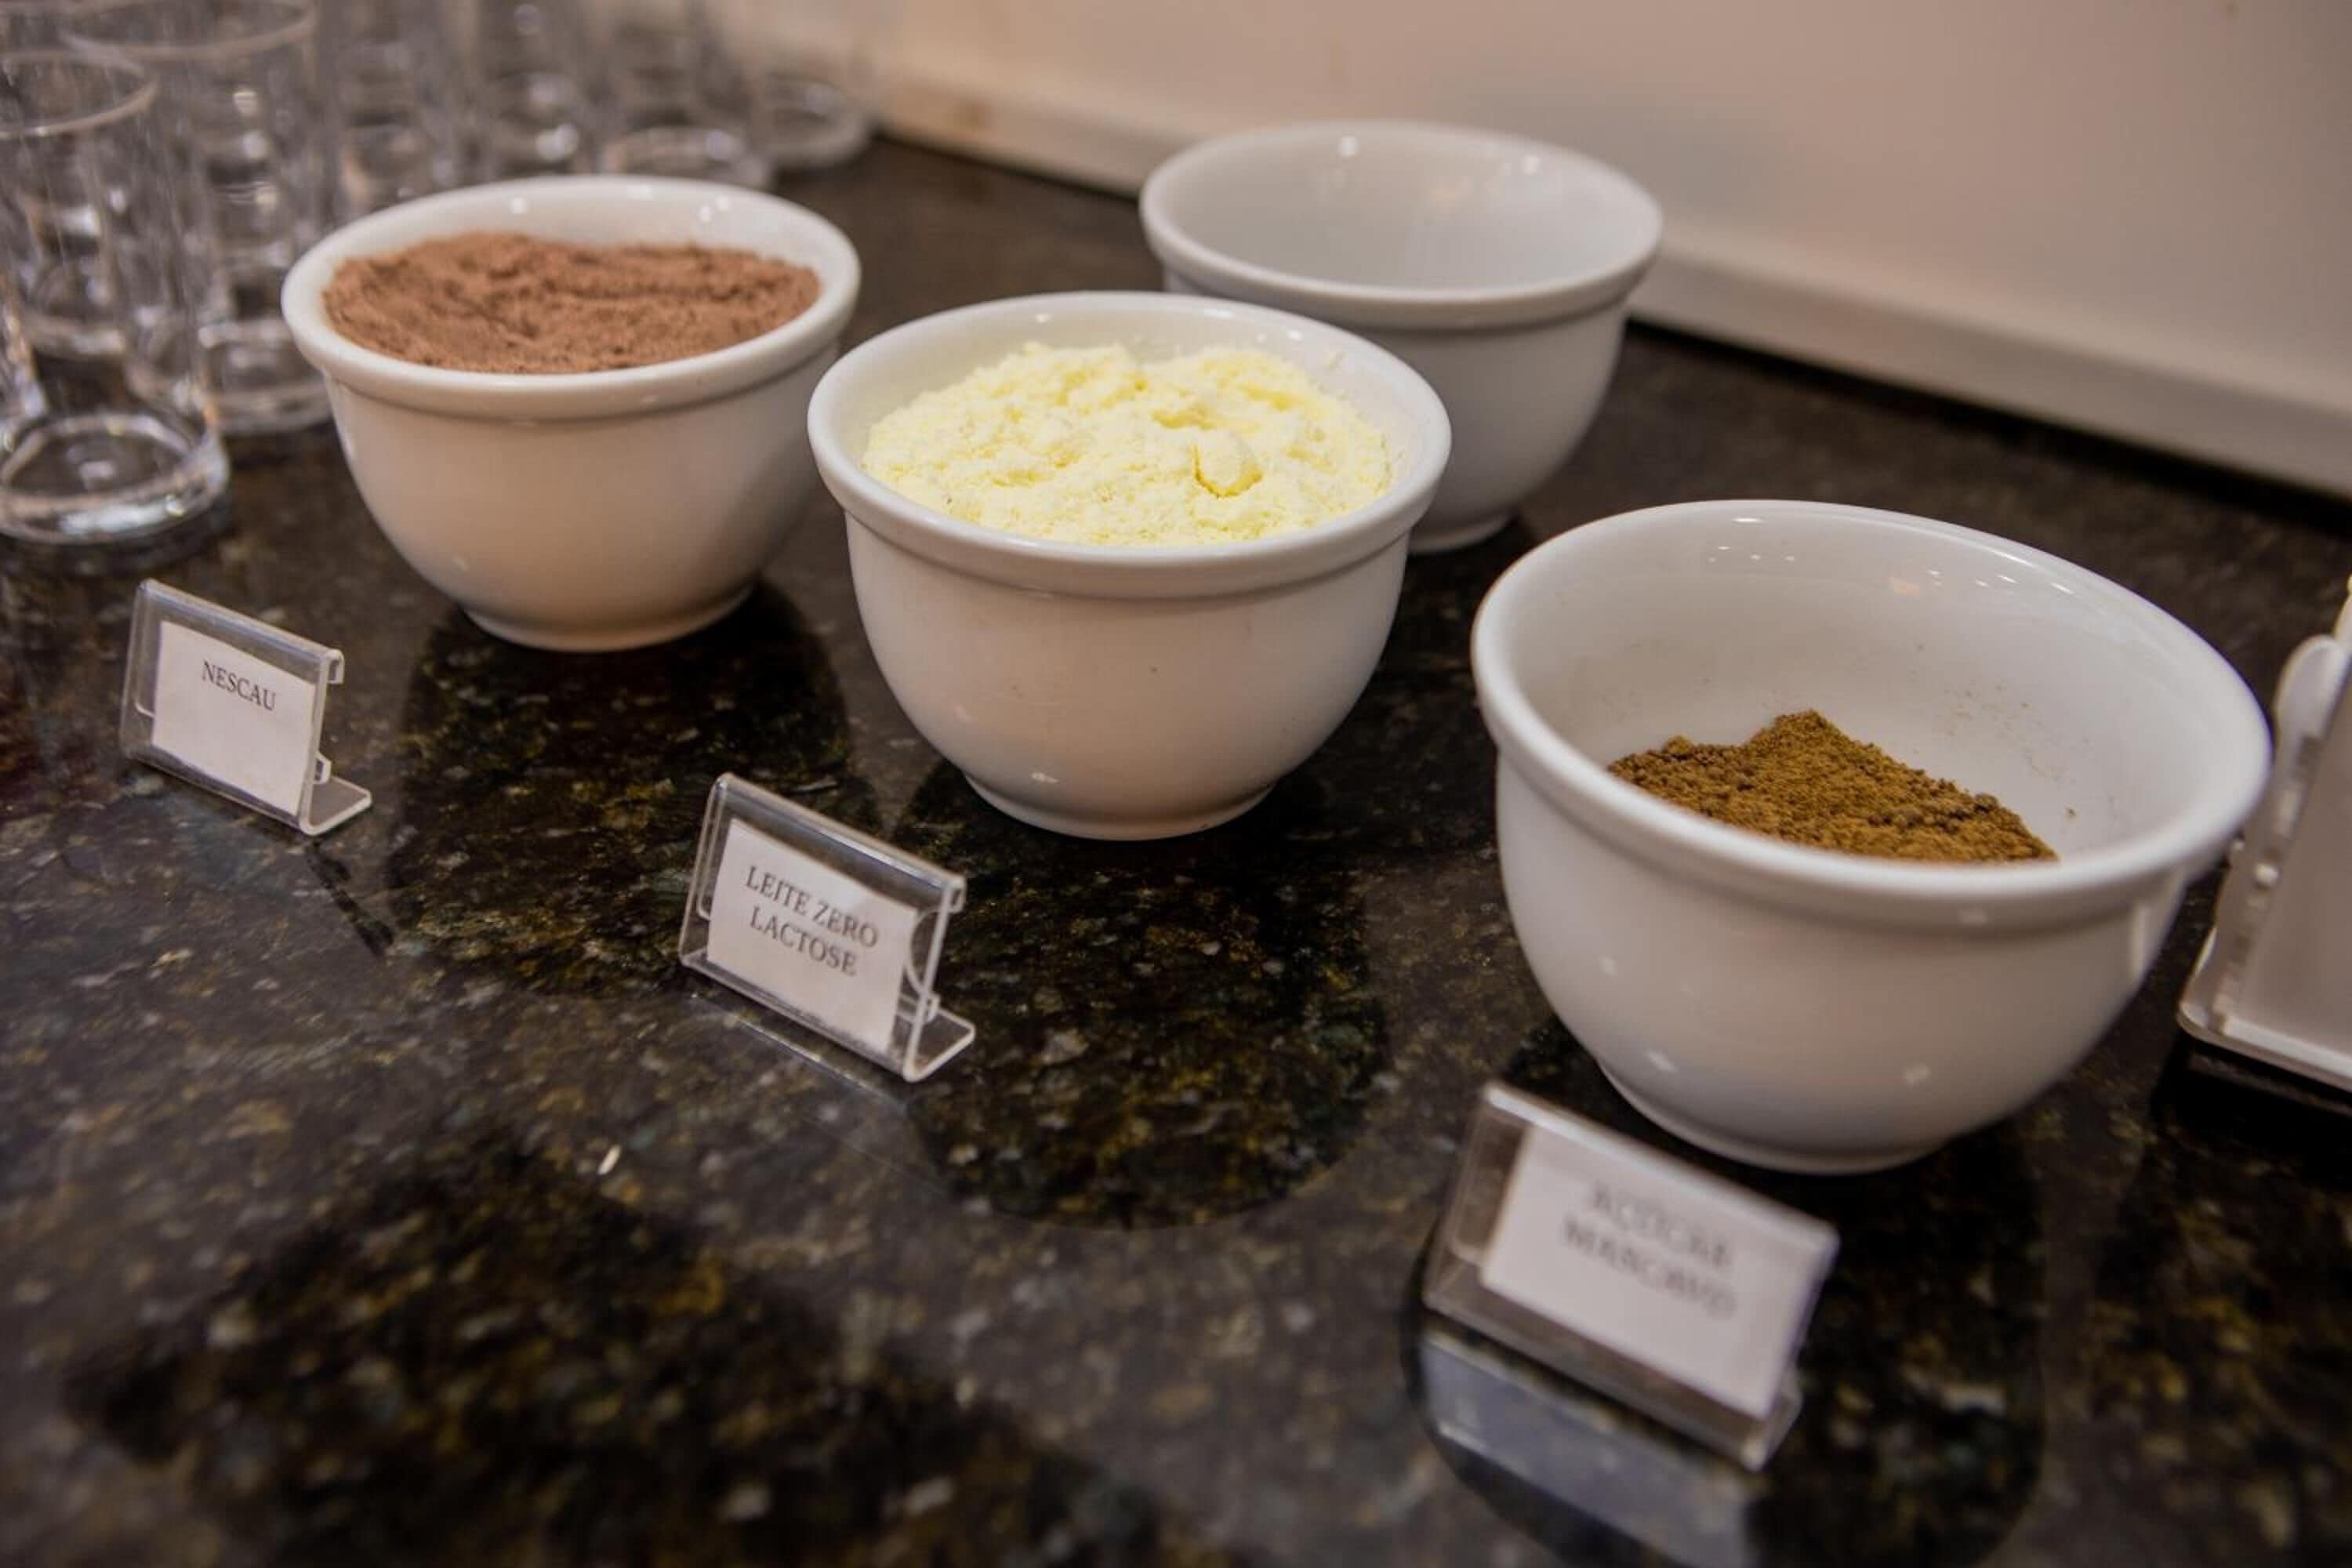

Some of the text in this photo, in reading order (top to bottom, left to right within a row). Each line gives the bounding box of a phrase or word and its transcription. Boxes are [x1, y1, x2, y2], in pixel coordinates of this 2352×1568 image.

[201, 661, 276, 710] NESCAU
[746, 865, 879, 948] LEITE ZERO
[750, 906, 857, 976] LACTOSE
